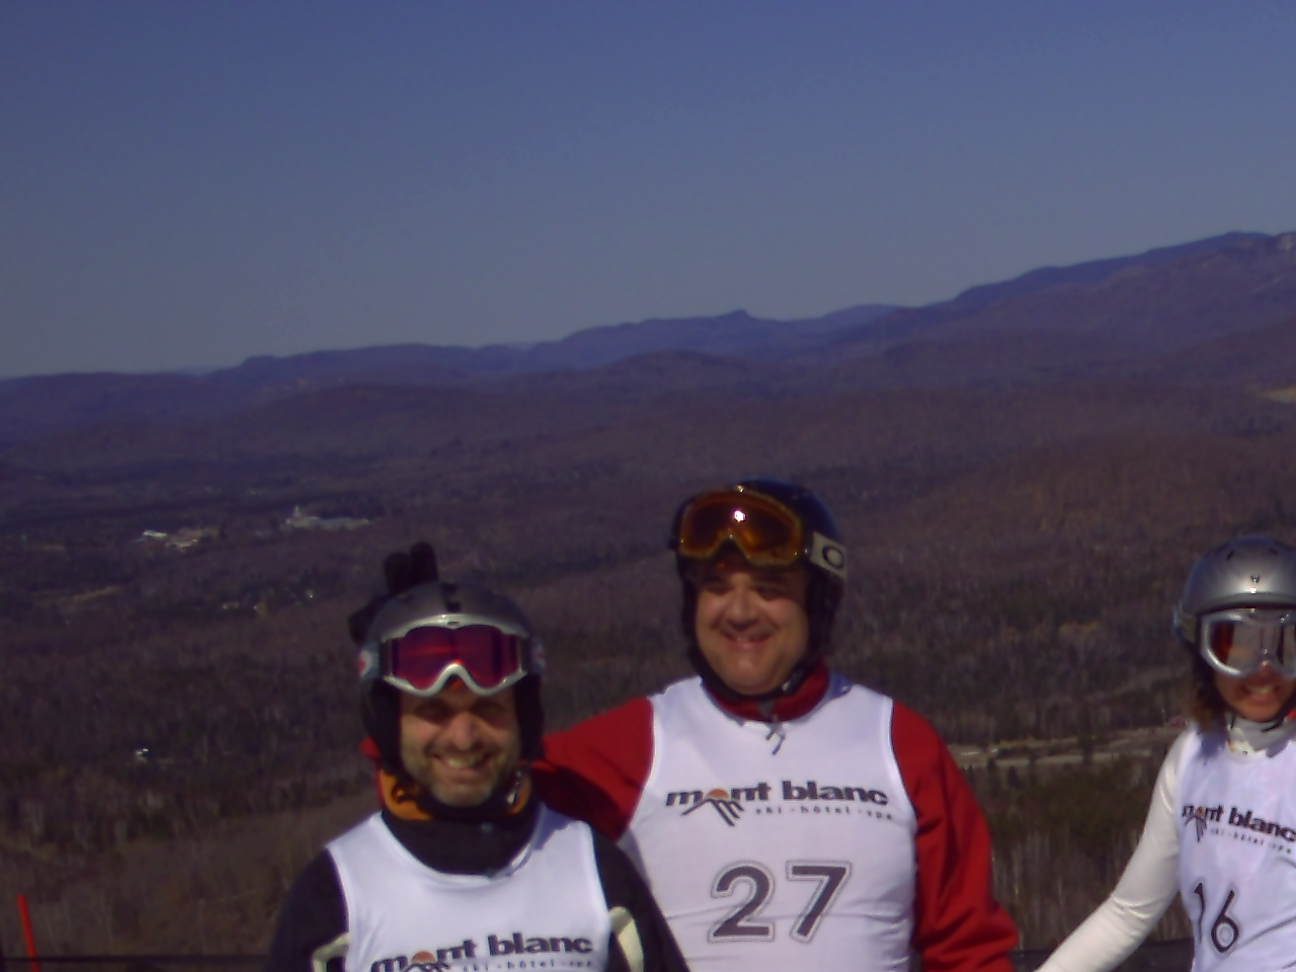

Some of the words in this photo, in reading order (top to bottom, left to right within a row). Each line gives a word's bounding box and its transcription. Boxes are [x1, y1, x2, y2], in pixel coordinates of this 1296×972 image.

[665, 781, 772, 807] mont
[781, 780, 889, 806] blanc
[709, 861, 850, 943] 27
[1192, 881, 1241, 953] 16
[487, 931, 594, 957] blanc
